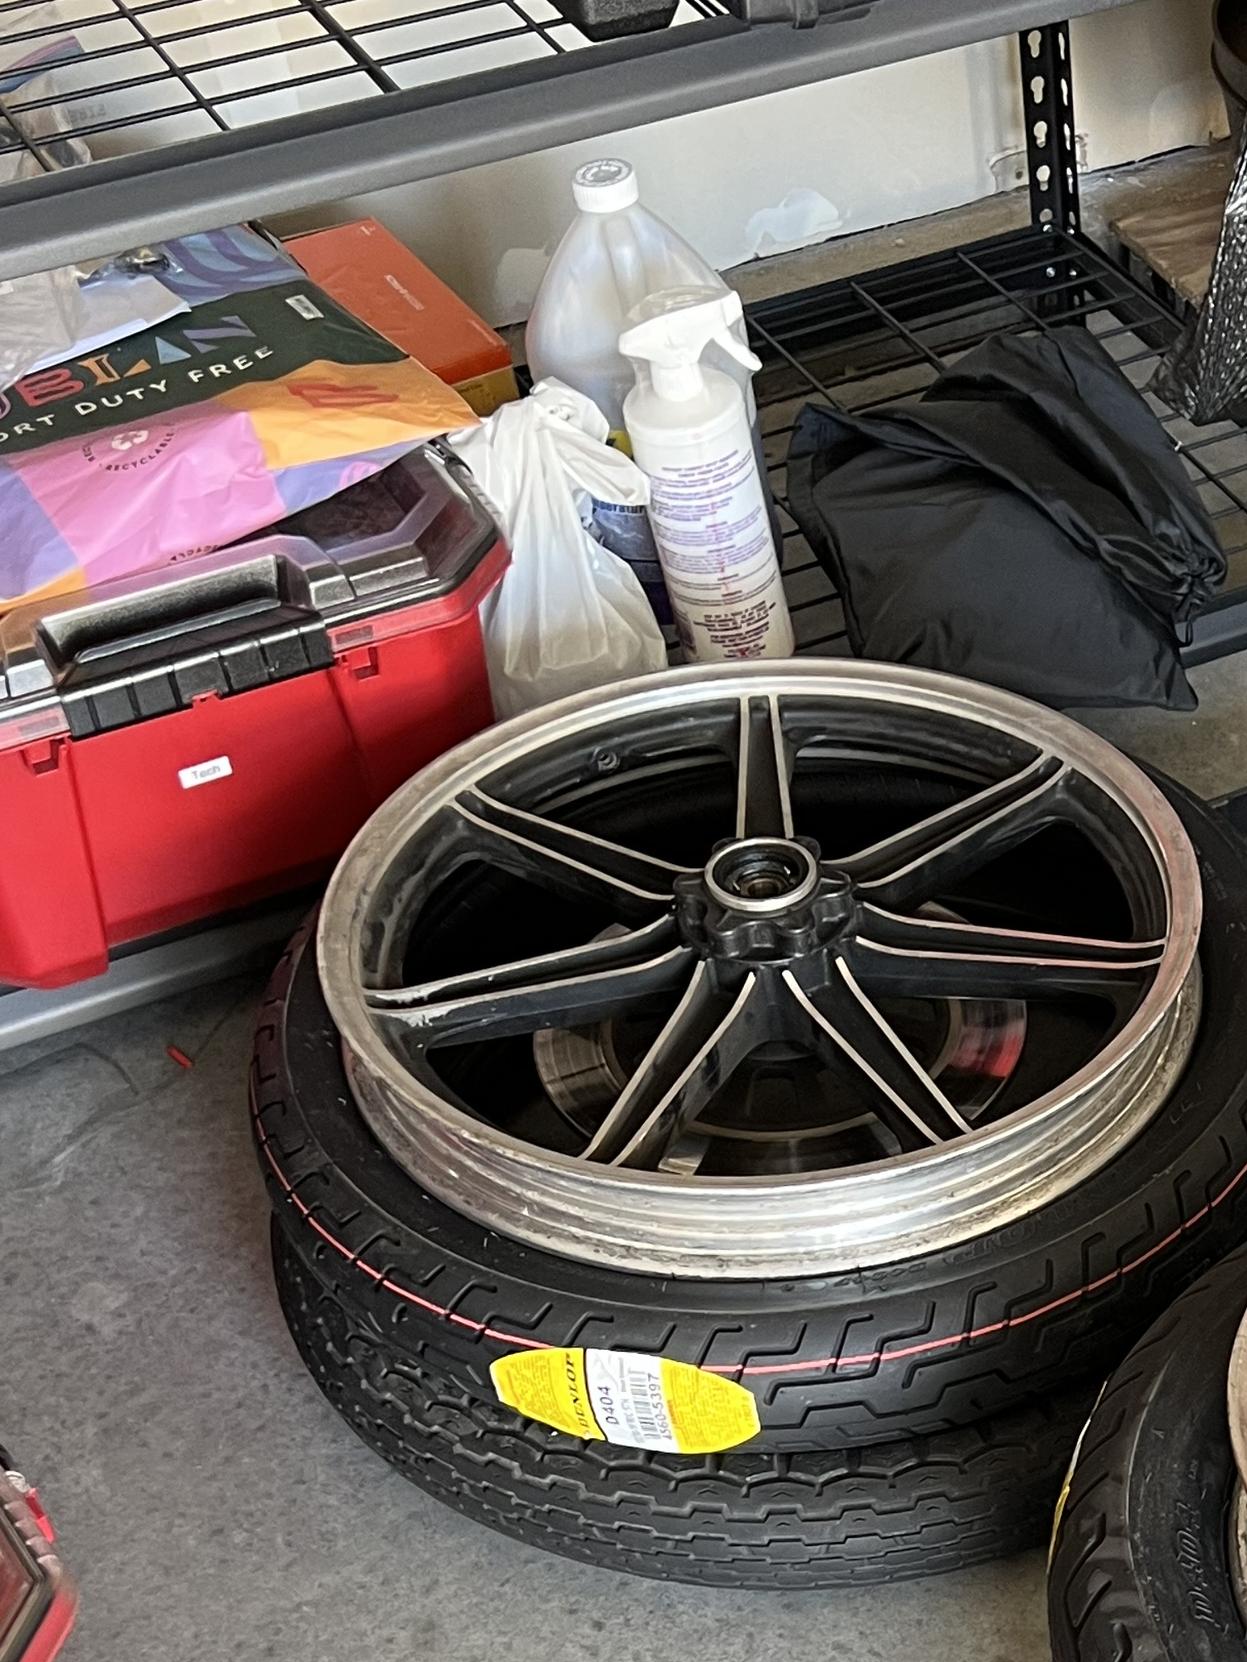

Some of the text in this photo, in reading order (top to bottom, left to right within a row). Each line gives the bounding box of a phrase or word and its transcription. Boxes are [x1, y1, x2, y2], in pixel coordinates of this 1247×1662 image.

[74, 379, 168, 416] DUTY
[187, 345, 274, 383] FREE
[564, 1351, 591, 1429] DUNLOP
[597, 1385, 620, 1426] D404
